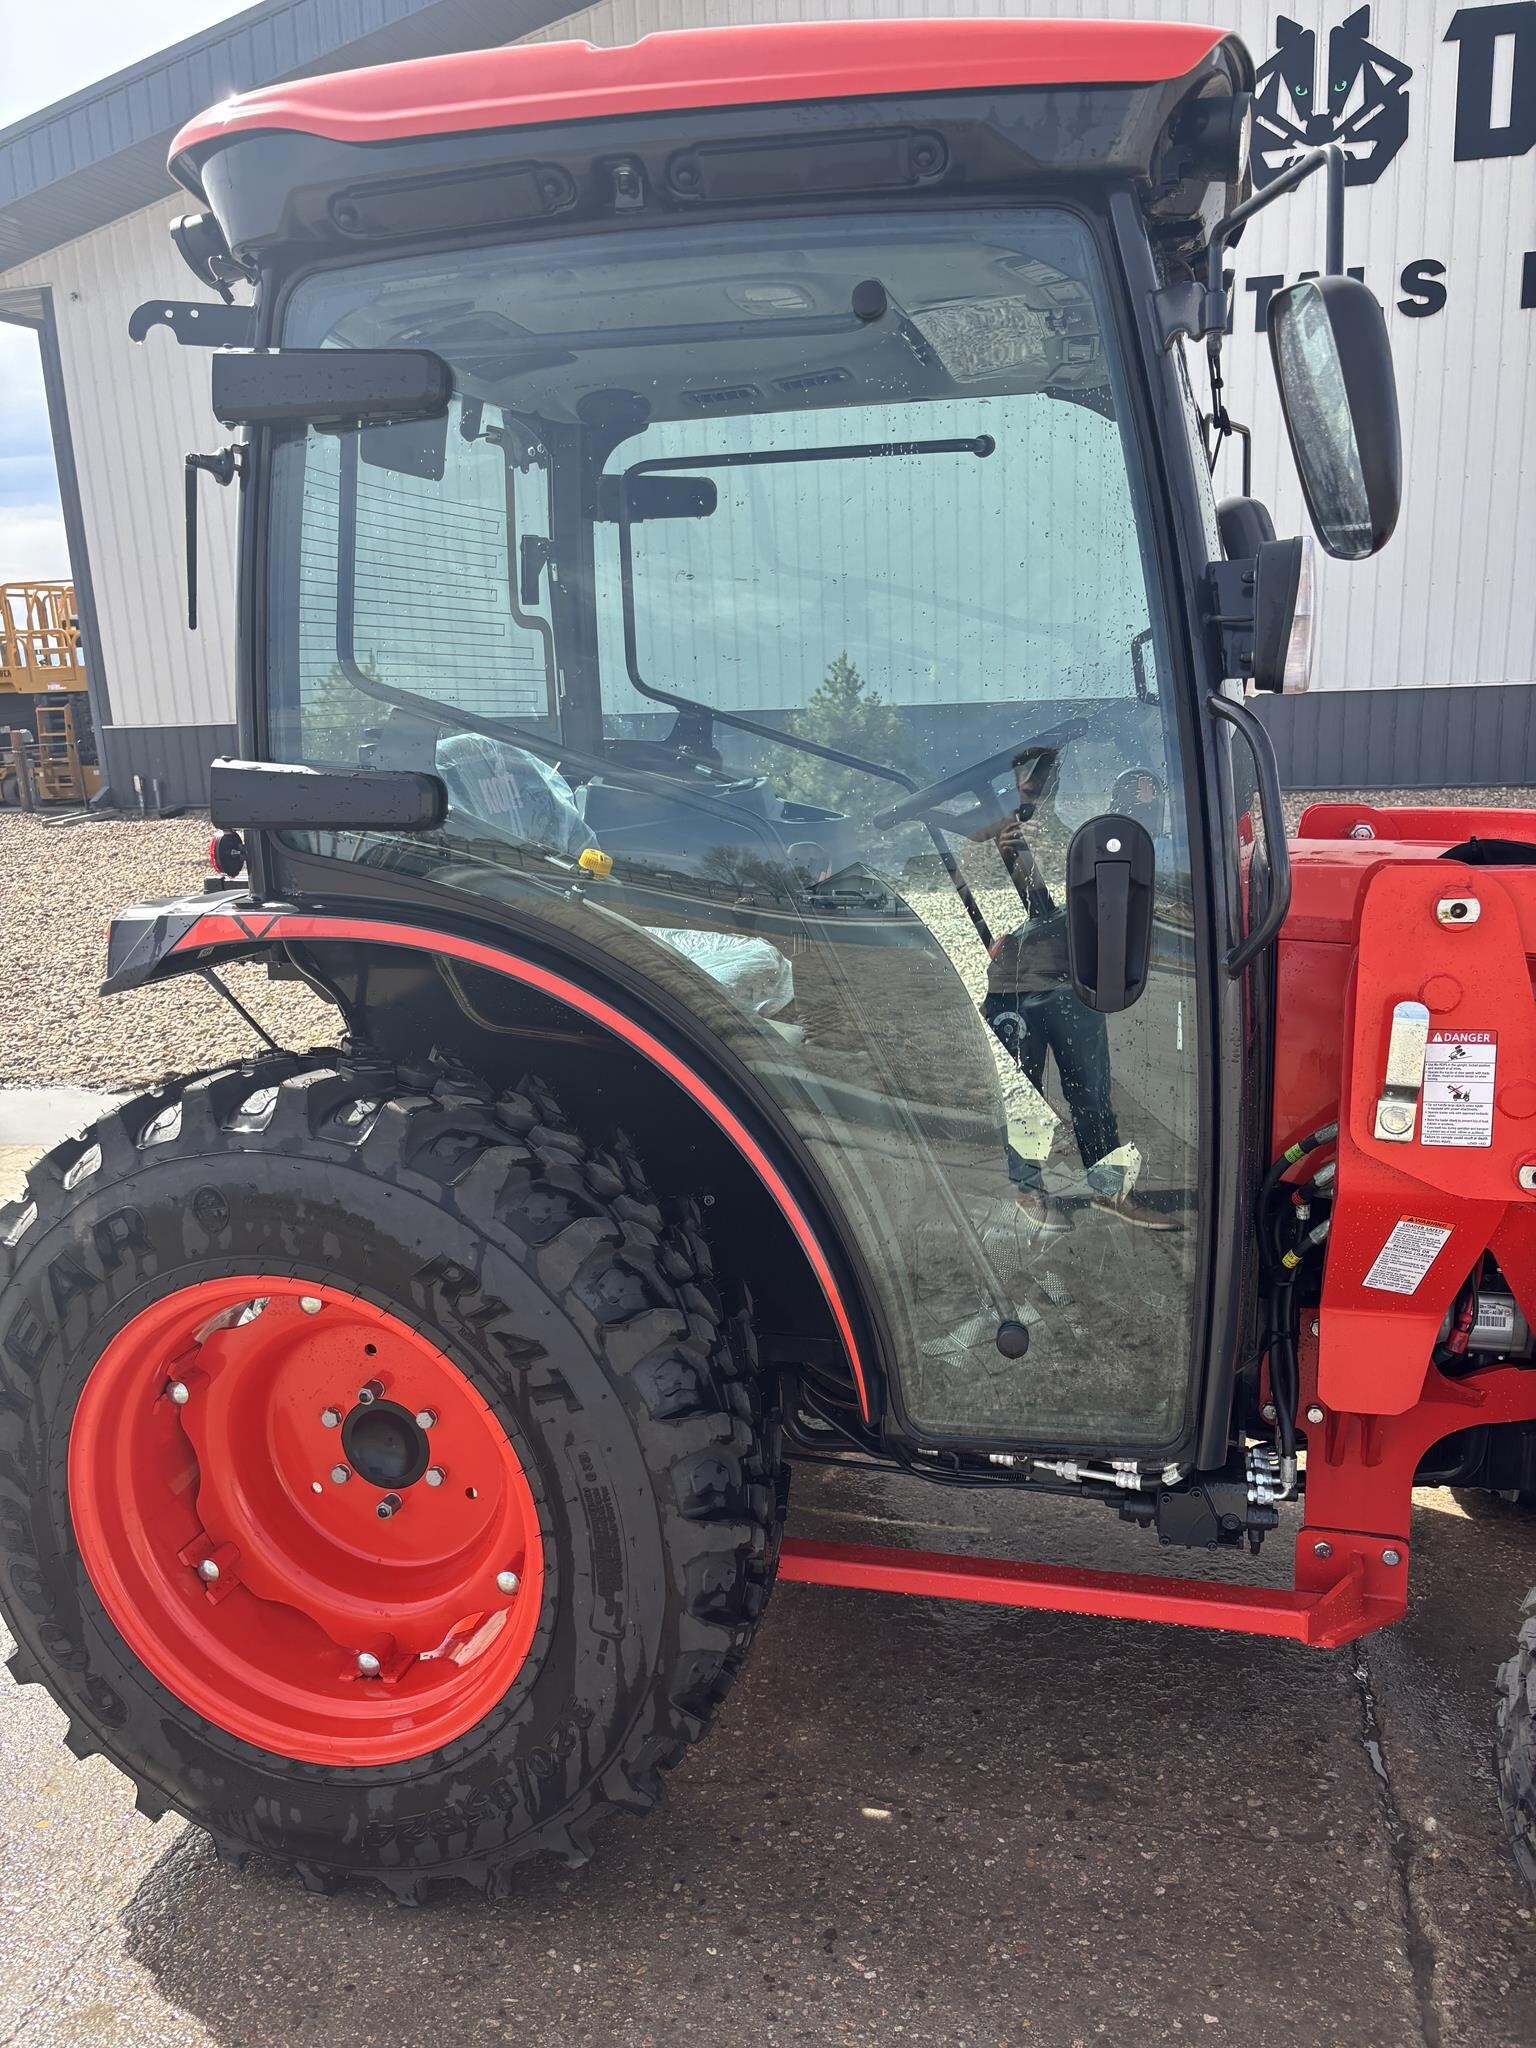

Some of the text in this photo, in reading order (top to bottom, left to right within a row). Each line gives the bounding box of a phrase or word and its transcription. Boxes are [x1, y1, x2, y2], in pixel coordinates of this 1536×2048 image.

[1444, 1033, 1490, 1042] DANGER
[1415, 1218, 1447, 1228] WARNING
[1384, 1246, 1412, 1255] INSTALLING
[1393, 1244, 1420, 1252] REMOVING
[410, 1254, 584, 1413] R14T
